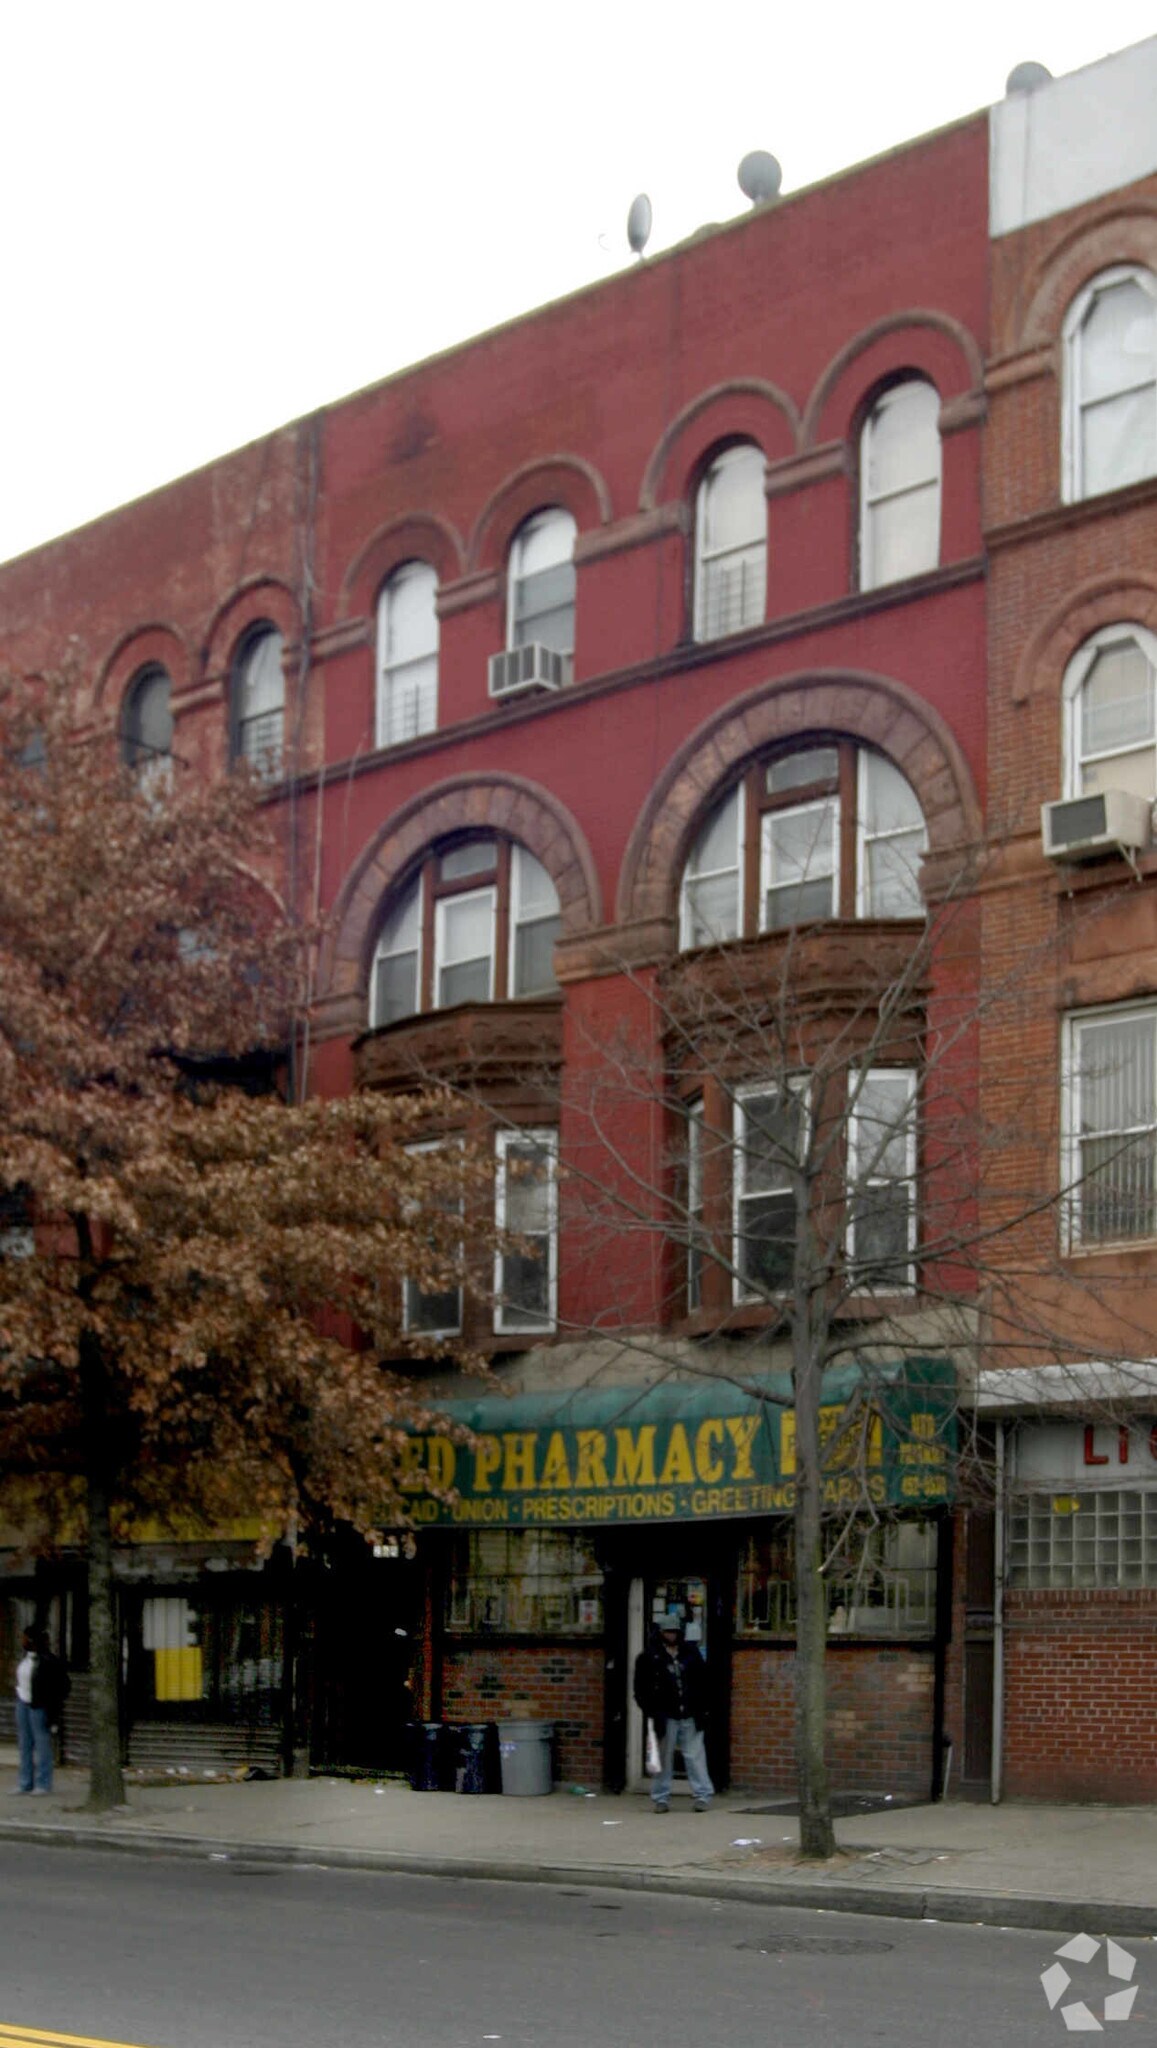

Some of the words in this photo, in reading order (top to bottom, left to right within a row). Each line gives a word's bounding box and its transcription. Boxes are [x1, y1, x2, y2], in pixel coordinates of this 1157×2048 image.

[472, 1414, 762, 1492] PHARMACY
[452, 1496, 508, 1522] UNION
[522, 1491, 676, 1522] PRESCRIPTIONS
[690, 1480, 797, 1516] GREETING
